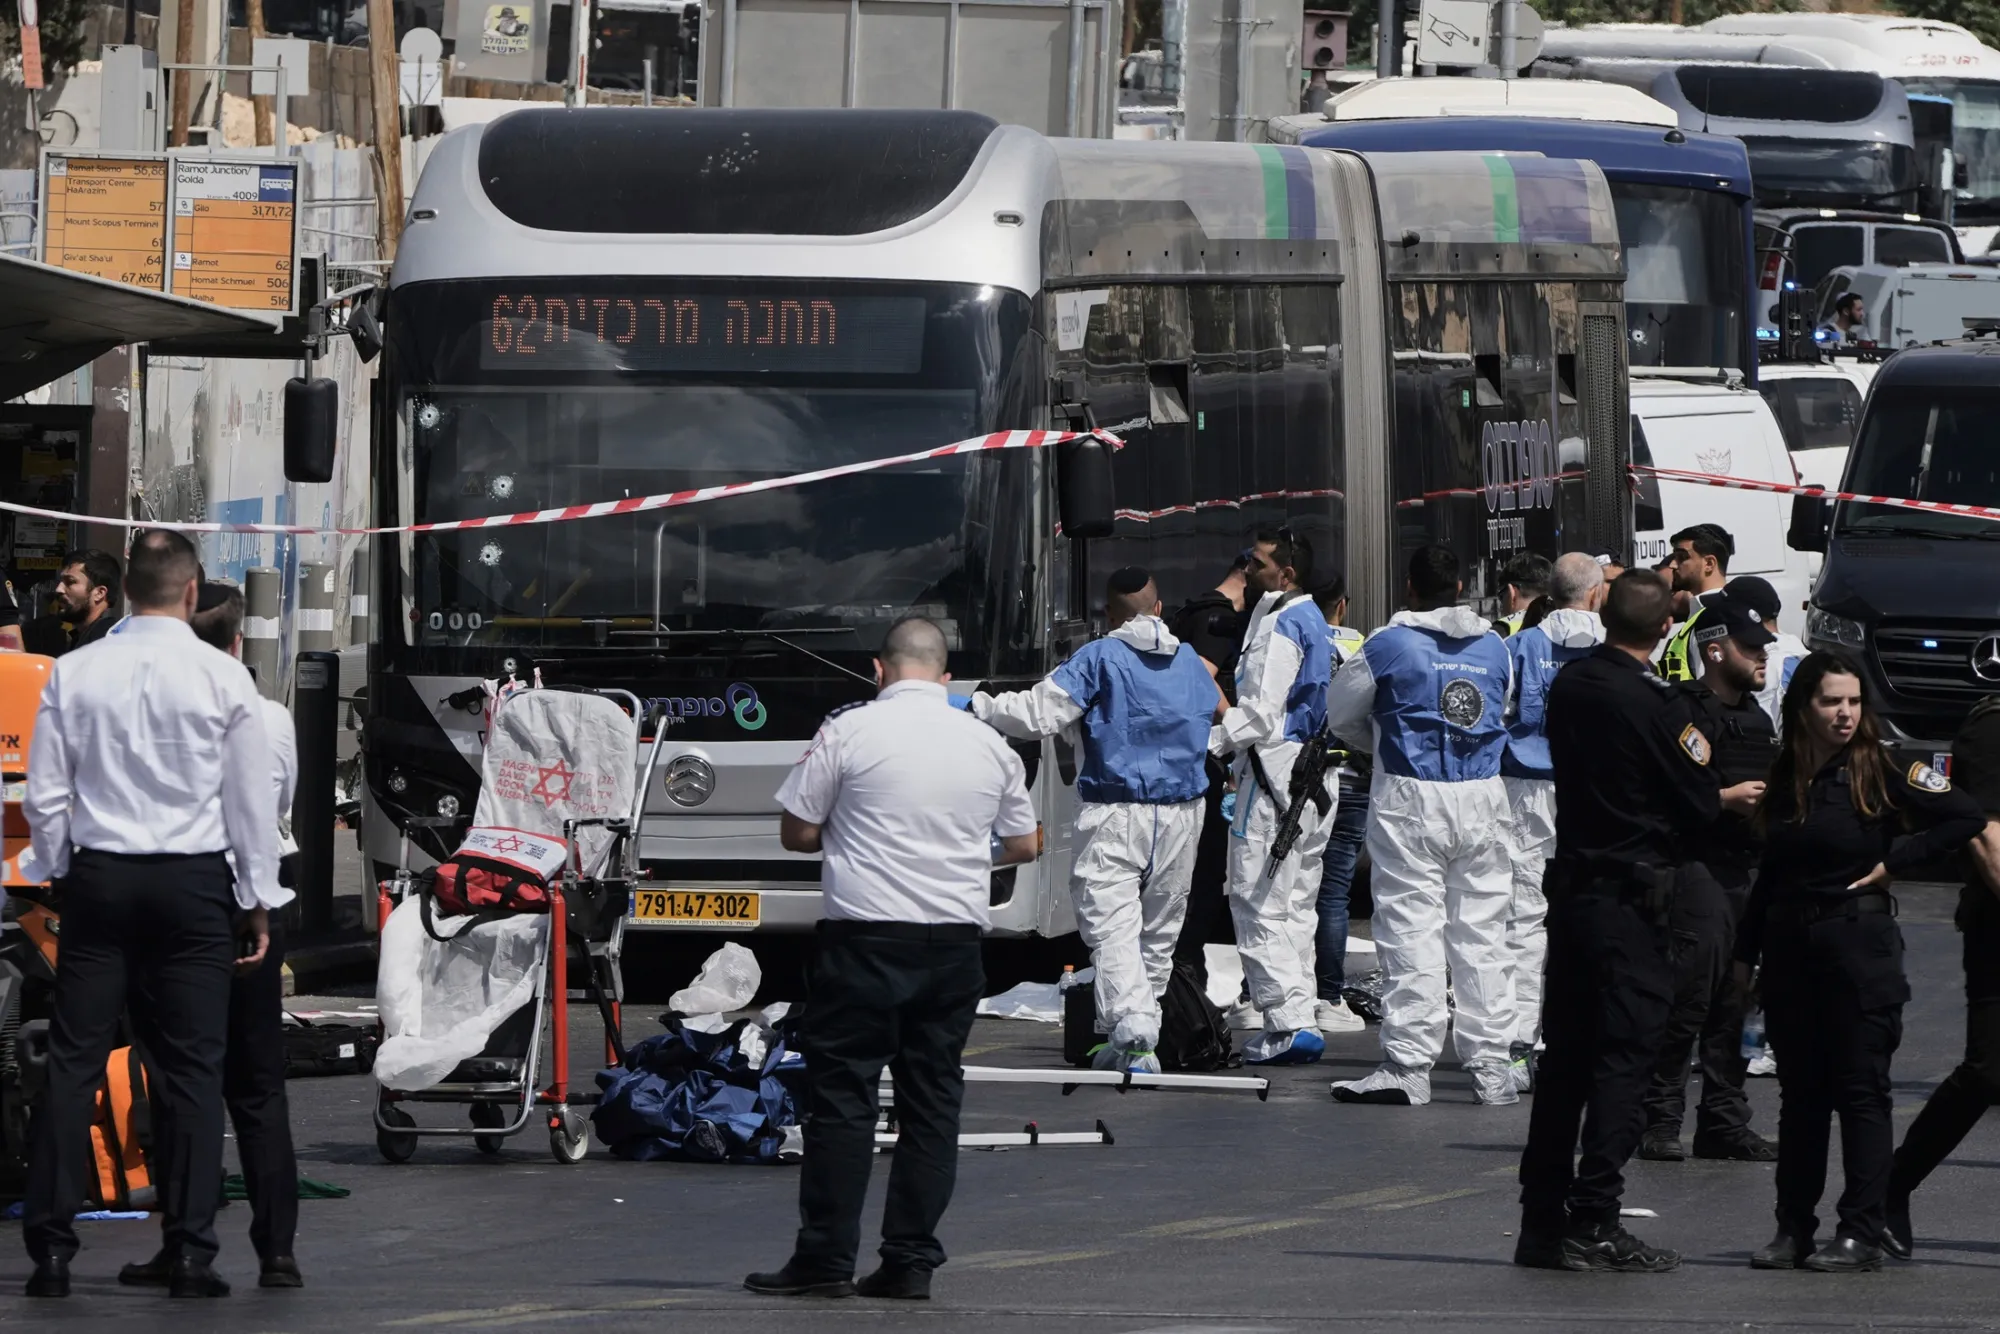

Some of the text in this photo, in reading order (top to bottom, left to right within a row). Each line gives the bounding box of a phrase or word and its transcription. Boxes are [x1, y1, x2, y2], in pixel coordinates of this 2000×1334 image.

[67, 163, 95, 173] Ramat
[177, 164, 208, 174] Ramot
[67, 177, 136, 188] Transport Center
[177, 175, 204, 184] Golda
[66, 186, 107, 195] HaArazim
[232, 191, 258, 200] 4009
[149, 201, 164, 211] 57
[194, 204, 210, 212] Gilo
[251, 205, 292, 218] 31,71,72
[65, 217, 159, 228] Mount Scopus Terminal
[151, 237, 163, 247] 61
[191, 258, 219, 267] Ramot
[275, 260, 290, 271] 62
[191, 276, 289, 288] Homat Schmuel 506
[270, 295, 289, 306] 516
[724, 299, 836, 345] תחנה
[1482, 418, 1554, 513] סופרבוס
[1635, 539, 1667, 560] משטר
[1431, 661, 1488, 675] משטרת ישראל
[1539, 657, 1566, 669] שראל
[502, 758, 537, 774] MAGEN
[496, 778, 525, 790] ADOM
